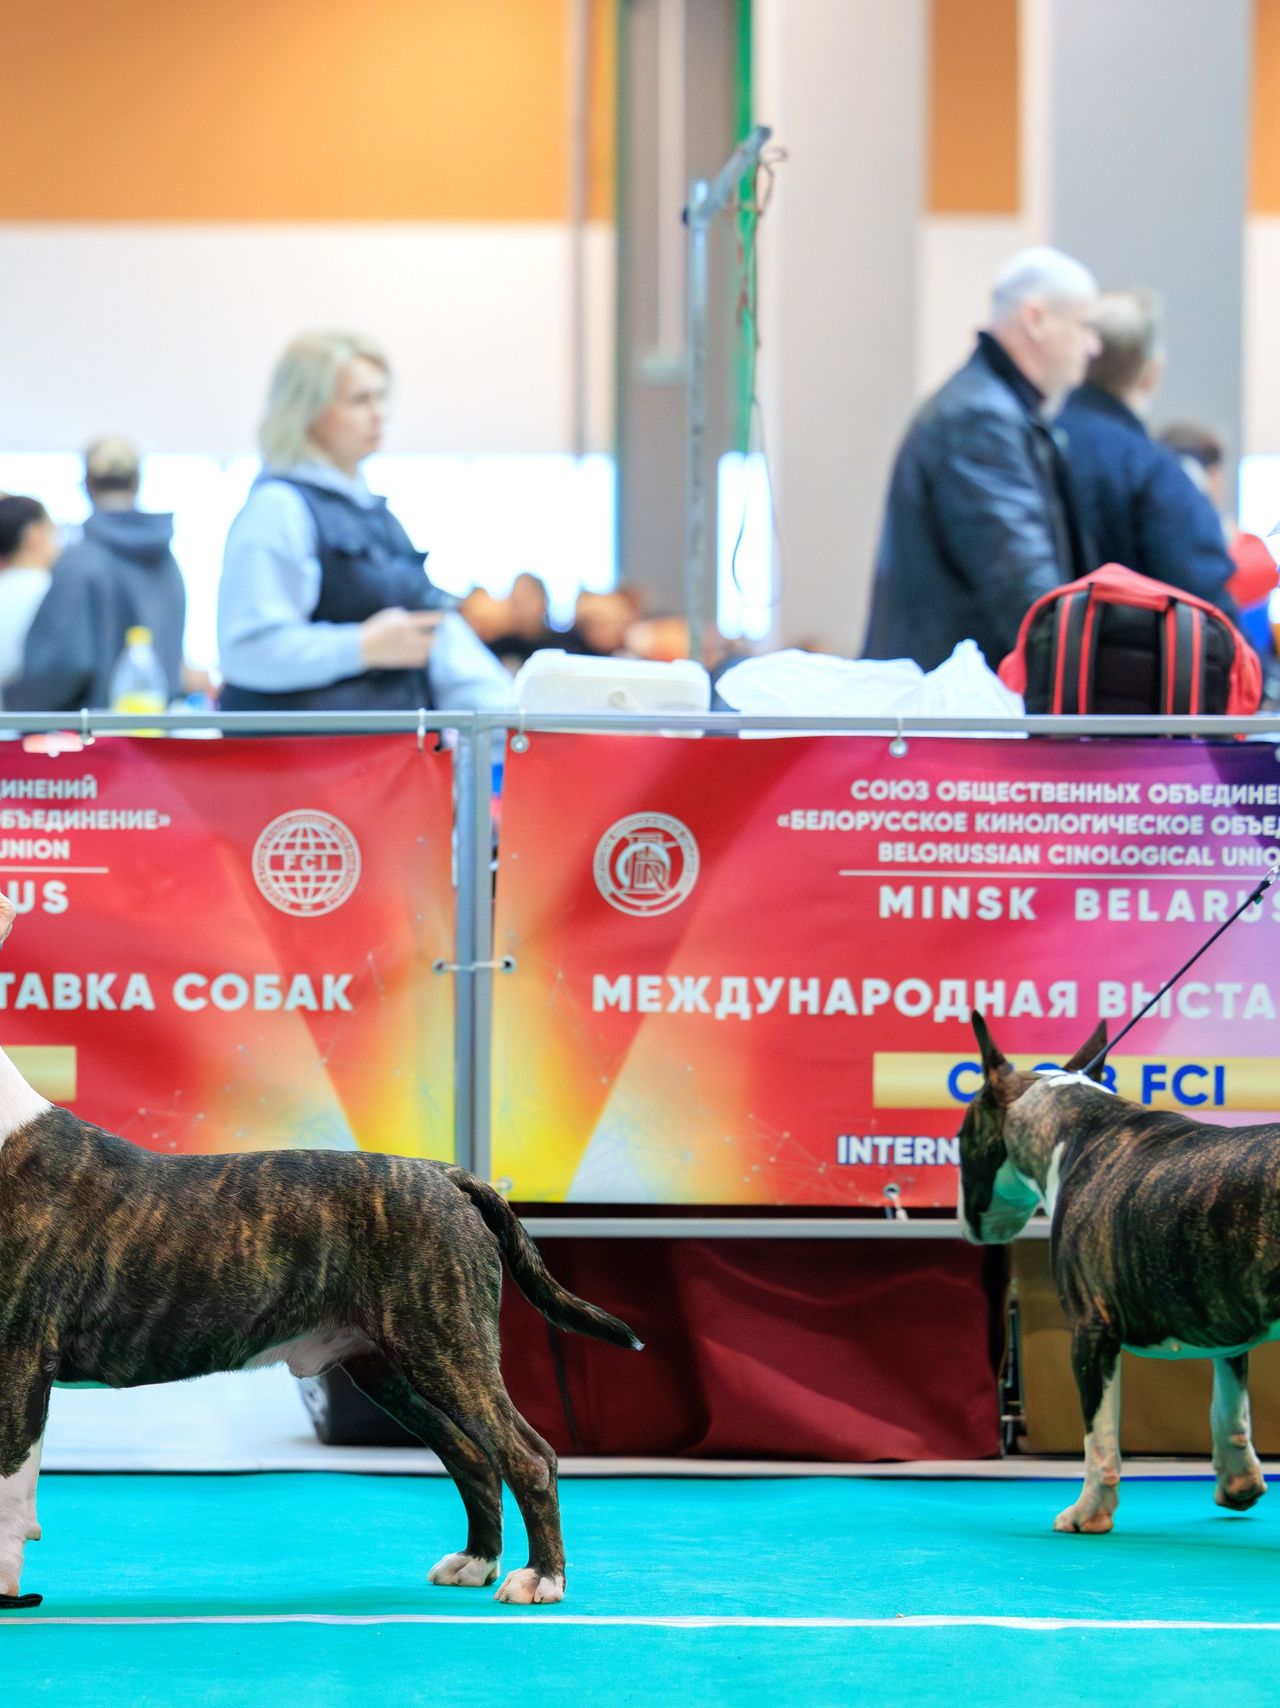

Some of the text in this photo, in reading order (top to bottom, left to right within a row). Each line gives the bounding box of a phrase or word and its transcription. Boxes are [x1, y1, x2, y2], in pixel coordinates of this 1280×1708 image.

[850, 779, 1280, 808] СОЮЗ ОБЩЕСТВЕННЫХ ОБЪЕДИНЕ
[776, 809, 968, 833] «БЕЛОРУССКОЕ
[974, 811, 1204, 835] КИНОЛОГИЧЕСКОЕ
[878, 841, 1041, 865] BELORUSSIAN
[1047, 844, 1215, 867] CINOLOGICAL
[879, 884, 1038, 920] MINSK
[171, 972, 355, 1012] СОБАК
[592, 974, 1277, 1023] МЕЖДУНАРОДНАЯ ВЫСТА
[1141, 1063, 1226, 1107] FCI
